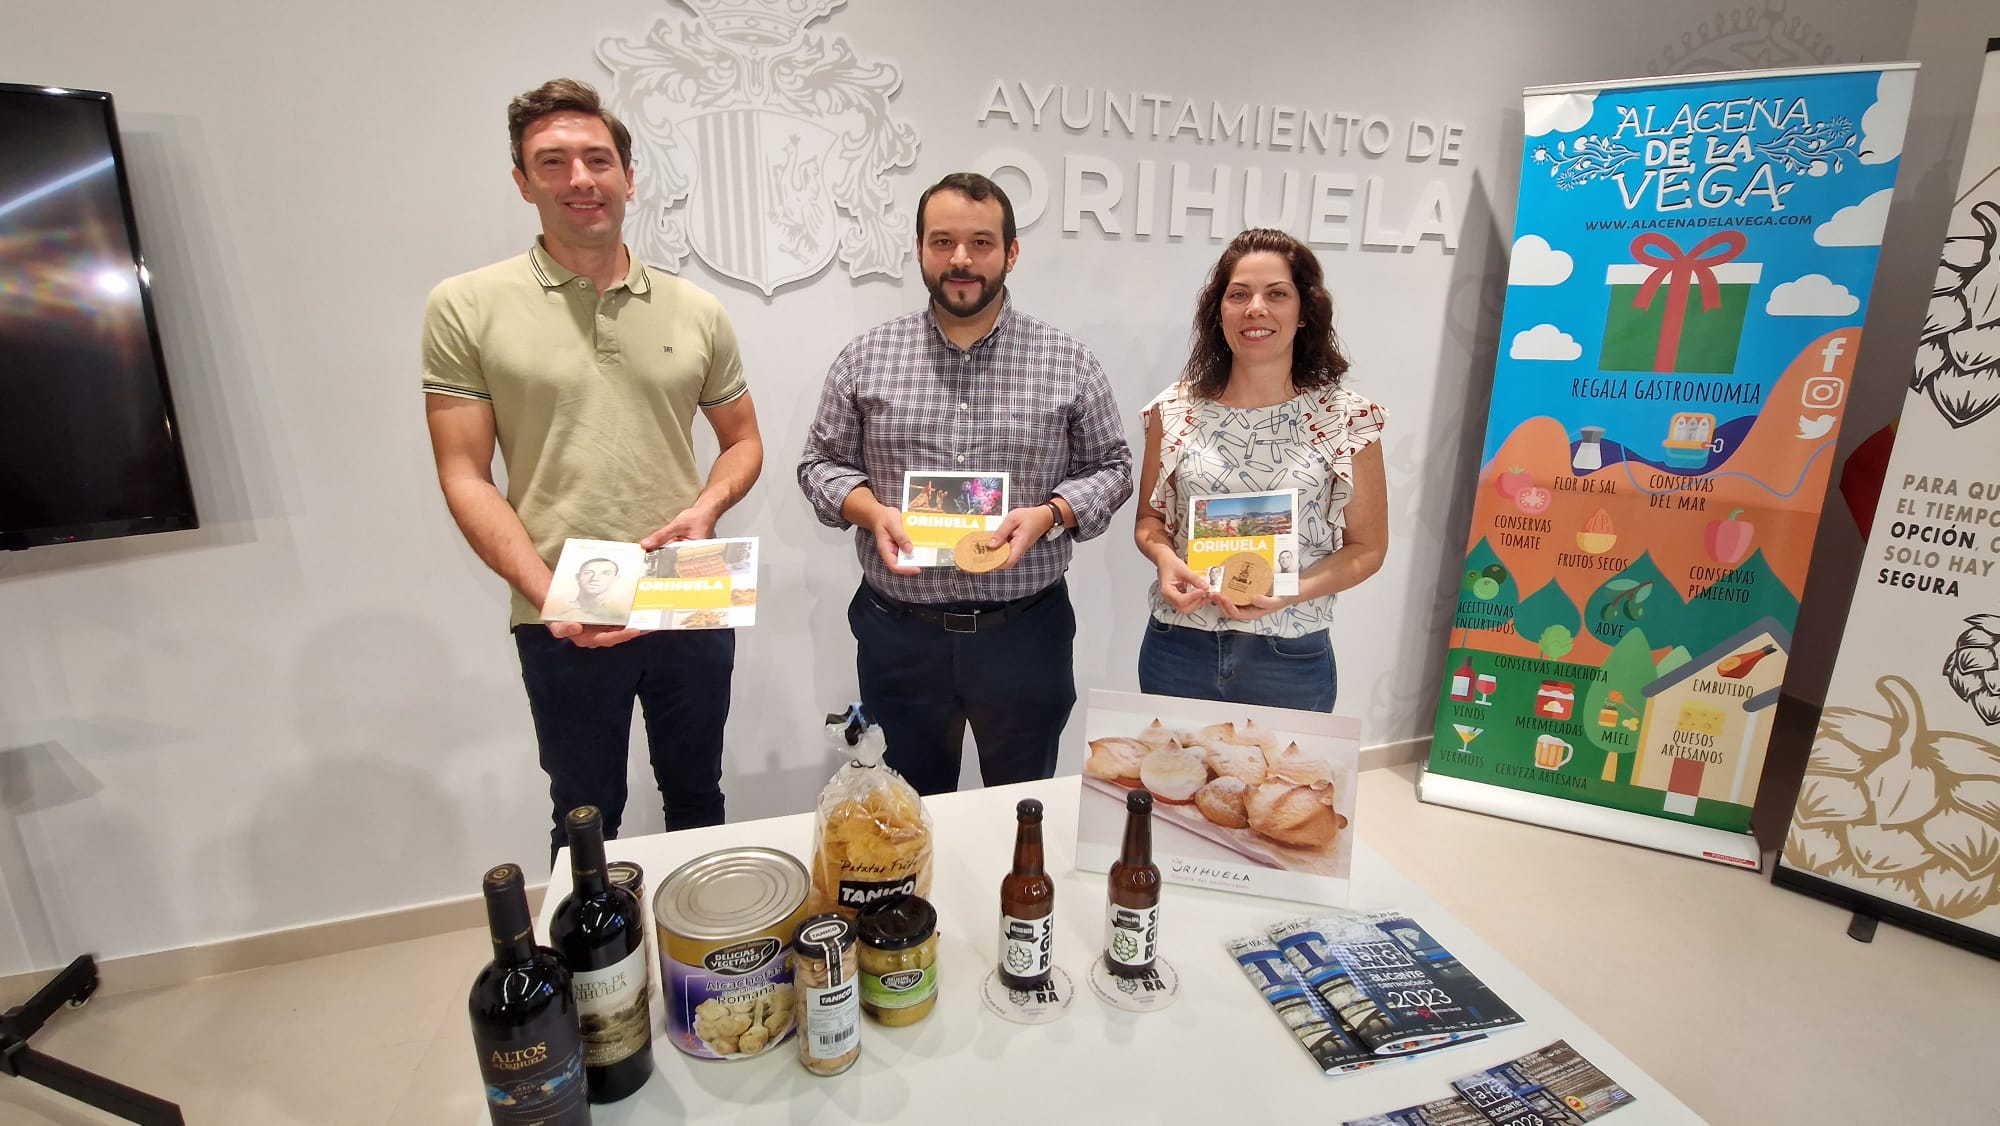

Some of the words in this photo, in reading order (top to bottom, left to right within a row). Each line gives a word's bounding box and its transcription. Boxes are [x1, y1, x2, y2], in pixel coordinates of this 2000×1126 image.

[977, 79, 1393, 155] AYUNTAMIENTO
[1407, 120, 1465, 163] DE
[1613, 96, 1809, 140] ALACENA
[1645, 134, 1693, 167] DE
[1705, 135, 1755, 164] LA
[1612, 163, 1790, 212] VEGA
[1585, 215, 1812, 231] WWW.ALACENADELAVEGA.COM
[1572, 376, 1628, 399] REGALA
[1633, 379, 1761, 405] GASTRONOMIA
[1554, 475, 1578, 493] FLOR
[1581, 477, 1596, 494] DE
[1599, 479, 1617, 495] SAL
[1649, 473, 1714, 493] CONSERVAS
[1902, 474, 1958, 496] PARA
[1650, 494, 1673, 509] DEL
[1677, 496, 1706, 512] MAR
[1896, 498, 1916, 515] EL
[907, 515, 981, 529] ORIHUELA
[1494, 514, 1552, 533] CONSERVAS
[1192, 538, 1269, 553] ORIHUELA
[1500, 533, 1541, 550] TOMATE
[1890, 521, 1979, 552] OPCIÓN,
[1557, 553, 1594, 570] FRUTOS
[1597, 555, 1629, 573] SECOS
[1883, 545, 1940, 569] SOLO
[1948, 555, 1995, 577] HAY
[1689, 565, 1756, 585] CONSERVAS
[1877, 568, 1960, 597] SEGURA
[638, 579, 724, 592] ORIHUELA
[1688, 584, 1750, 604] PIMIENTO
[1455, 616, 1516, 636] ENCURTIDOS
[1595, 622, 1625, 638] AOVE
[1494, 655, 1551, 675] CONSERVAS
[1692, 678, 1755, 699] EMBUTIDO
[1453, 705, 1486, 721] VINOS
[1515, 715, 1584, 737] MERMELADAS
[1600, 729, 1630, 746] MIEL
[1673, 730, 1715, 748] QUESOS
[1440, 749, 1485, 769] VERMUTS
[1661, 744, 1724, 765] ARTESANOS
[1495, 761, 1536, 780] CERVEZA
[1537, 770, 1588, 790] ARTESANA
[841, 860, 886, 873] Patatas
[1172, 859, 1251, 881] ORIHUELA
[811, 926, 839, 939] TANICO
[711, 953, 760, 968] VEGETALES
[715, 948, 755, 961] DELICIAS
[706, 966, 783, 992] Alcachofas
[1141, 980, 1167, 992] RA
[717, 984, 776, 1005] Romana
[820, 988, 852, 1004] TANICO
[1036, 992, 1060, 1004] RA
[1388, 987, 1453, 1008] 2023
[492, 1041, 547, 1063] ALTOS
